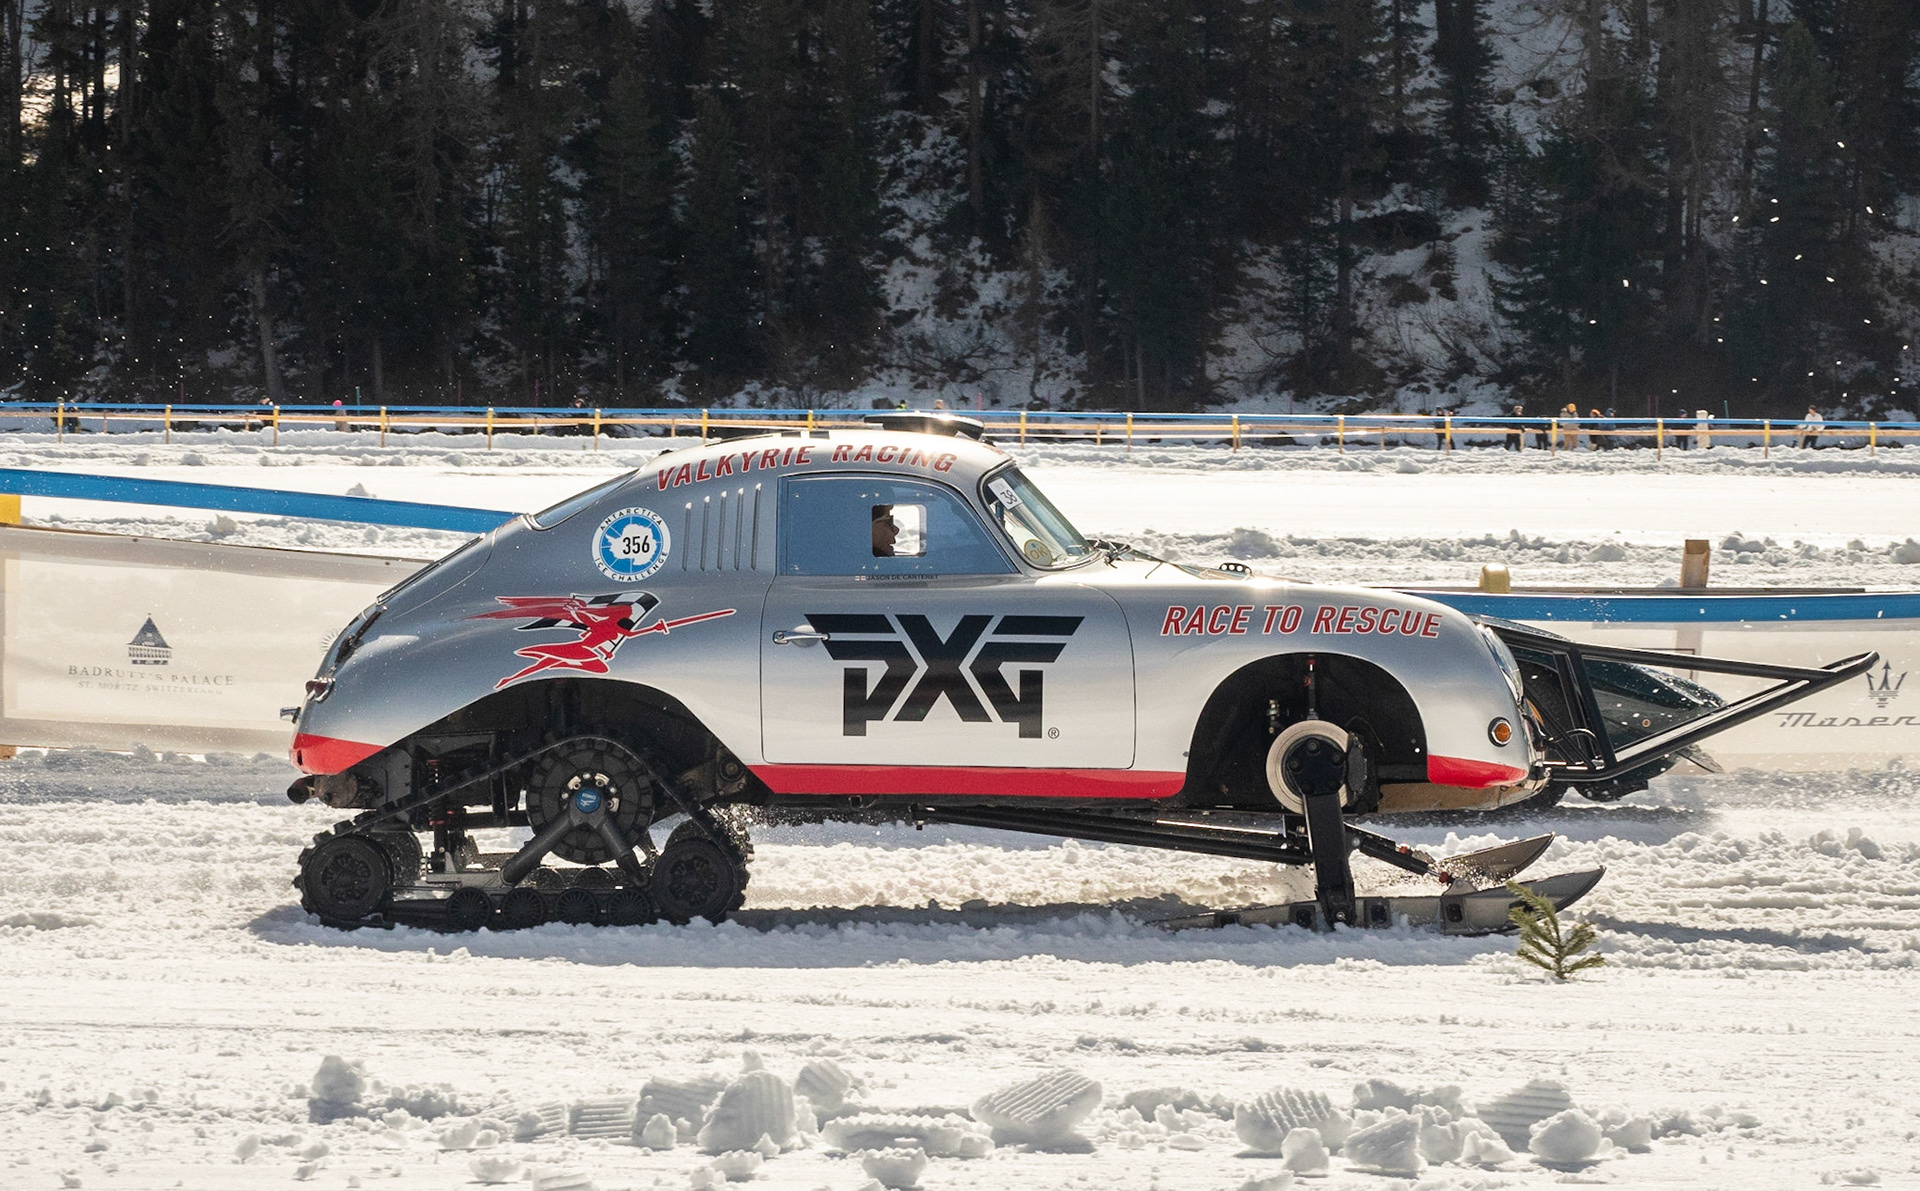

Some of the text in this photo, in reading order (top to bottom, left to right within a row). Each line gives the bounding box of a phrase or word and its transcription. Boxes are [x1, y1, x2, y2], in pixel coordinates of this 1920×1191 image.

[657, 444, 957, 492] VALKYRIE RACING
[600, 507, 662, 531] ANTARCTICA
[622, 535, 650, 554] 356
[611, 552, 668, 581] CHALLENGE
[1160, 605, 1443, 638] RACE TO RESCUE
[68, 665, 234, 686] BADRUTT'S PALACE
[804, 614, 1085, 738] PXG
